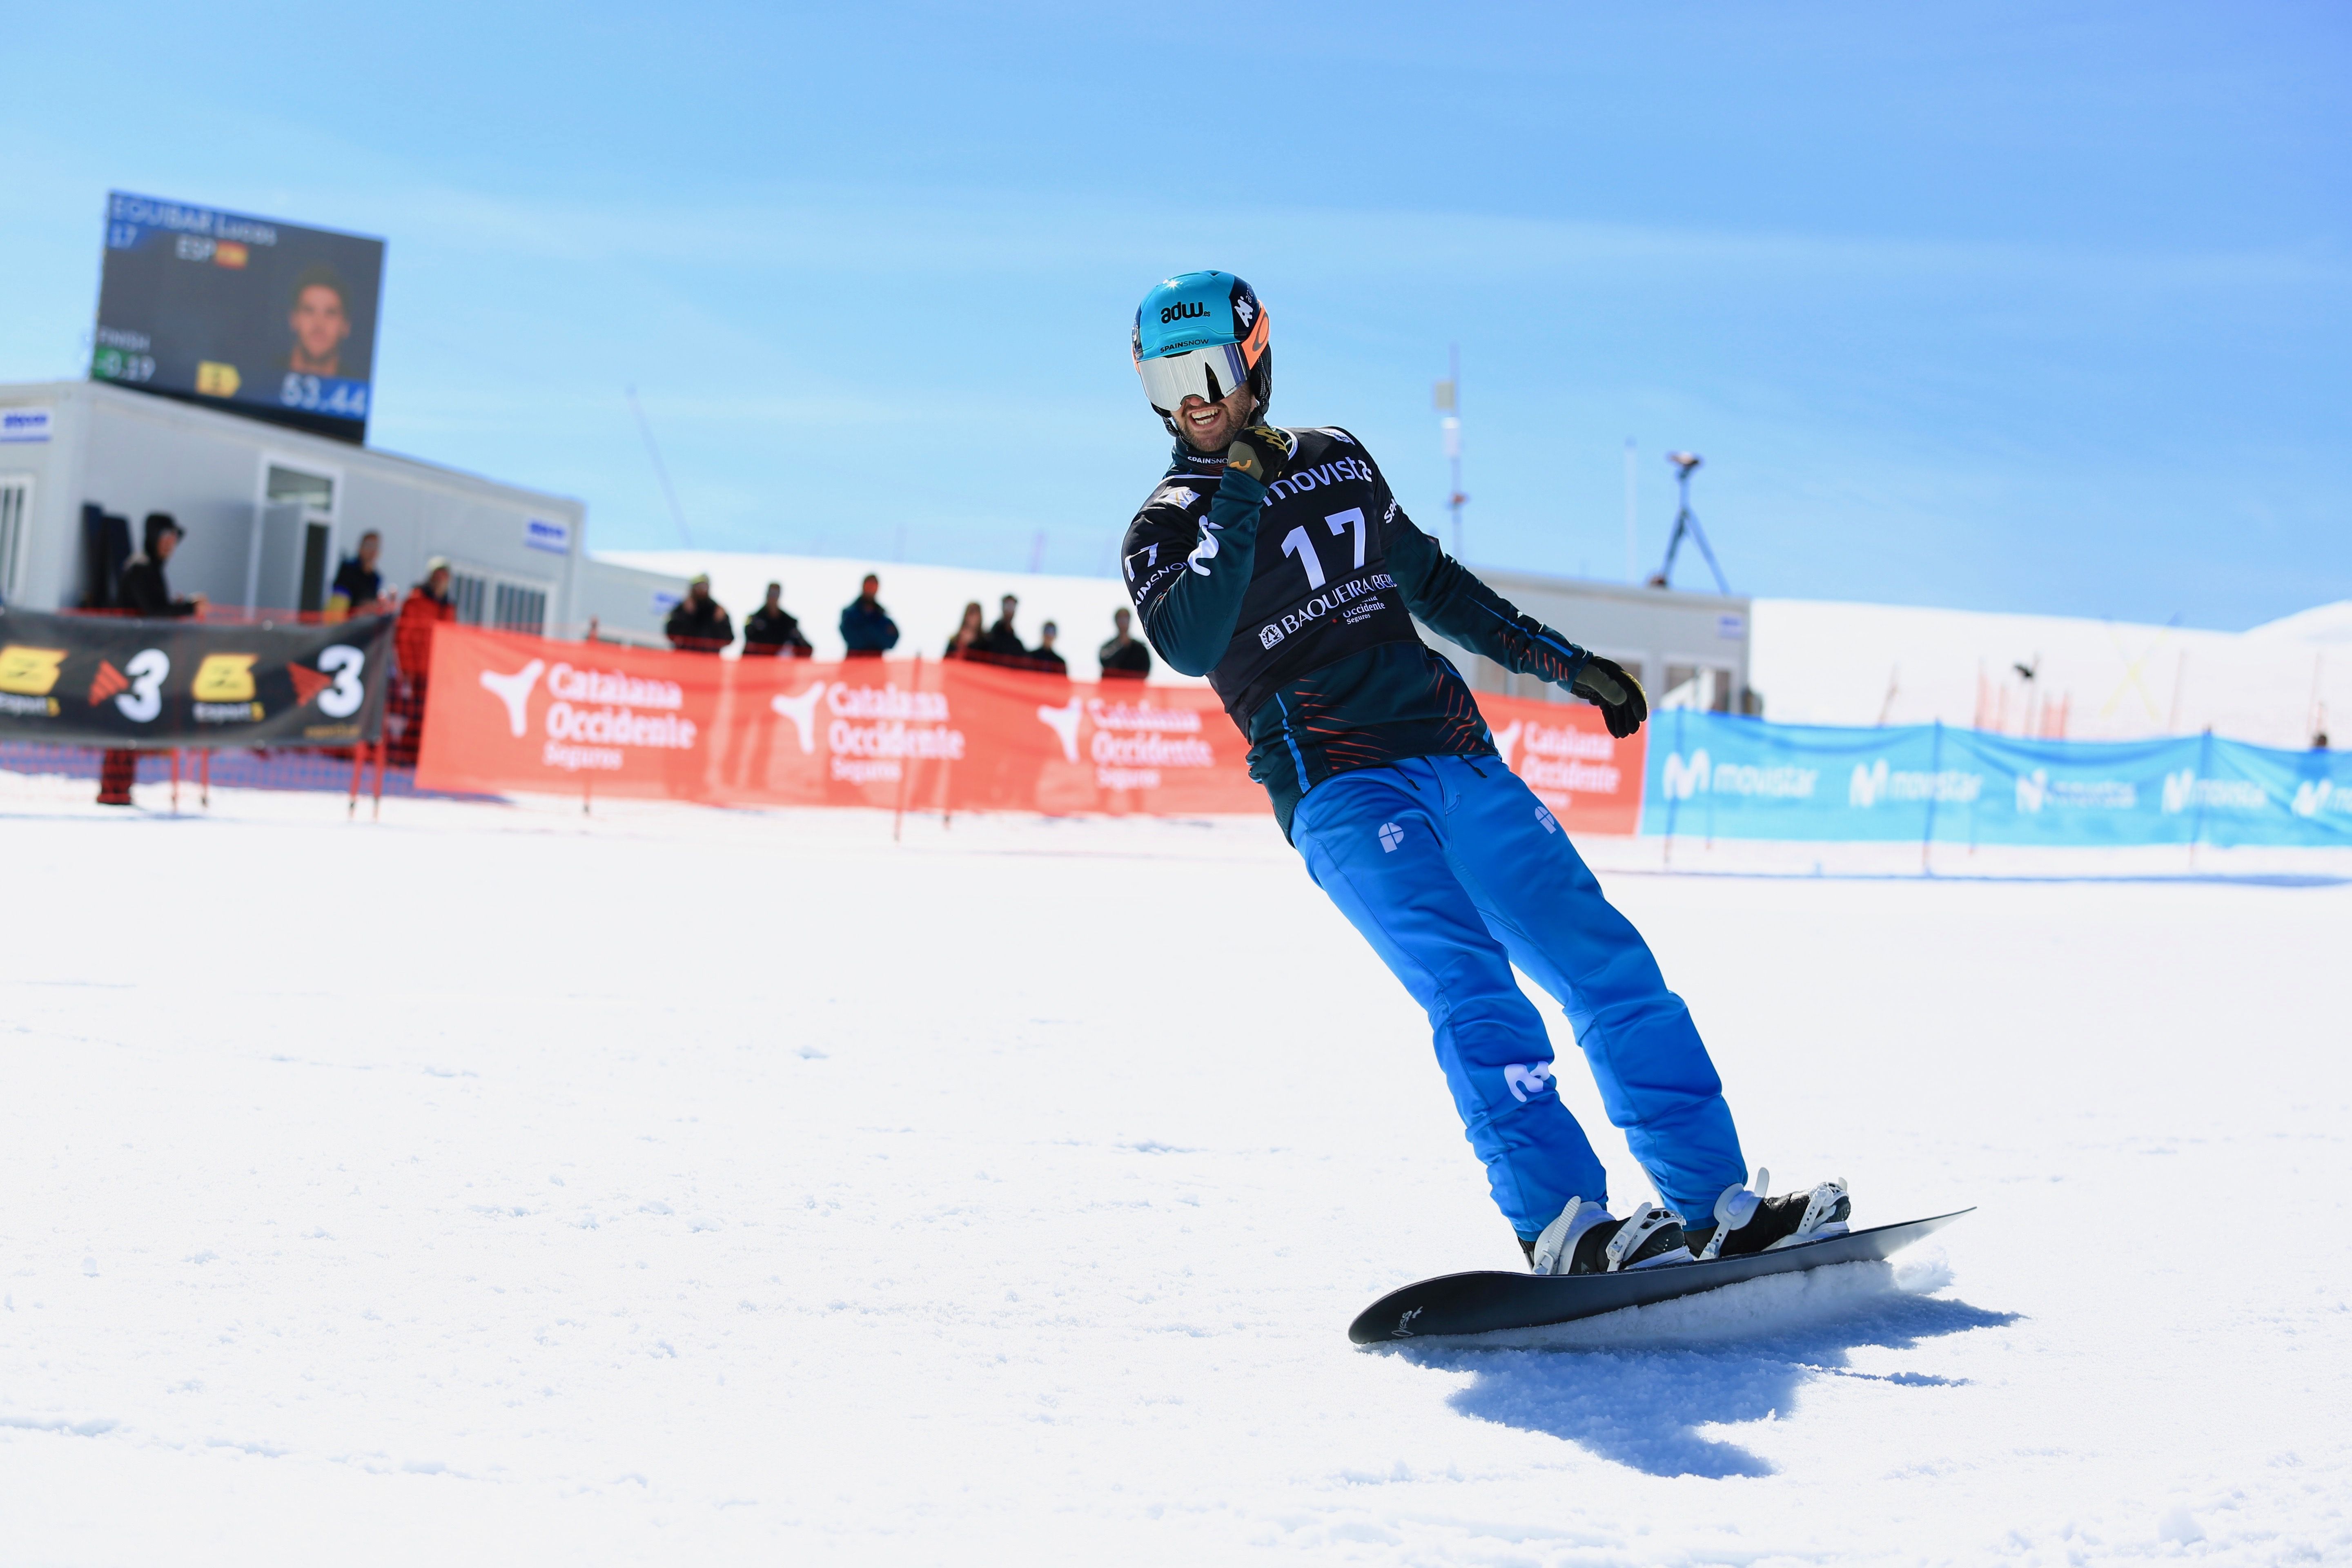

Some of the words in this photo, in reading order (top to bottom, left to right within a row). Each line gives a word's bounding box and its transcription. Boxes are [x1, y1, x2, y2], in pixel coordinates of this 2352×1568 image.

[1160, 339, 1209, 353] SPAINSNOW
[1281, 507, 1366, 592] 17
[1135, 562, 1187, 612] AINSNO
[1346, 613, 1371, 625] Seguros
[115, 648, 170, 723] 3
[317, 644, 365, 719] 3
[547, 662, 683, 710] Catalana
[827, 682, 949, 722] Catalana
[546, 702, 697, 750] Occidente
[828, 719, 965, 760] Occidente
[543, 740, 623, 771] Seguros
[1091, 731, 1215, 766] Occidente
[1713, 762, 1818, 799] movistar
[1888, 770, 1983, 802] movistar
